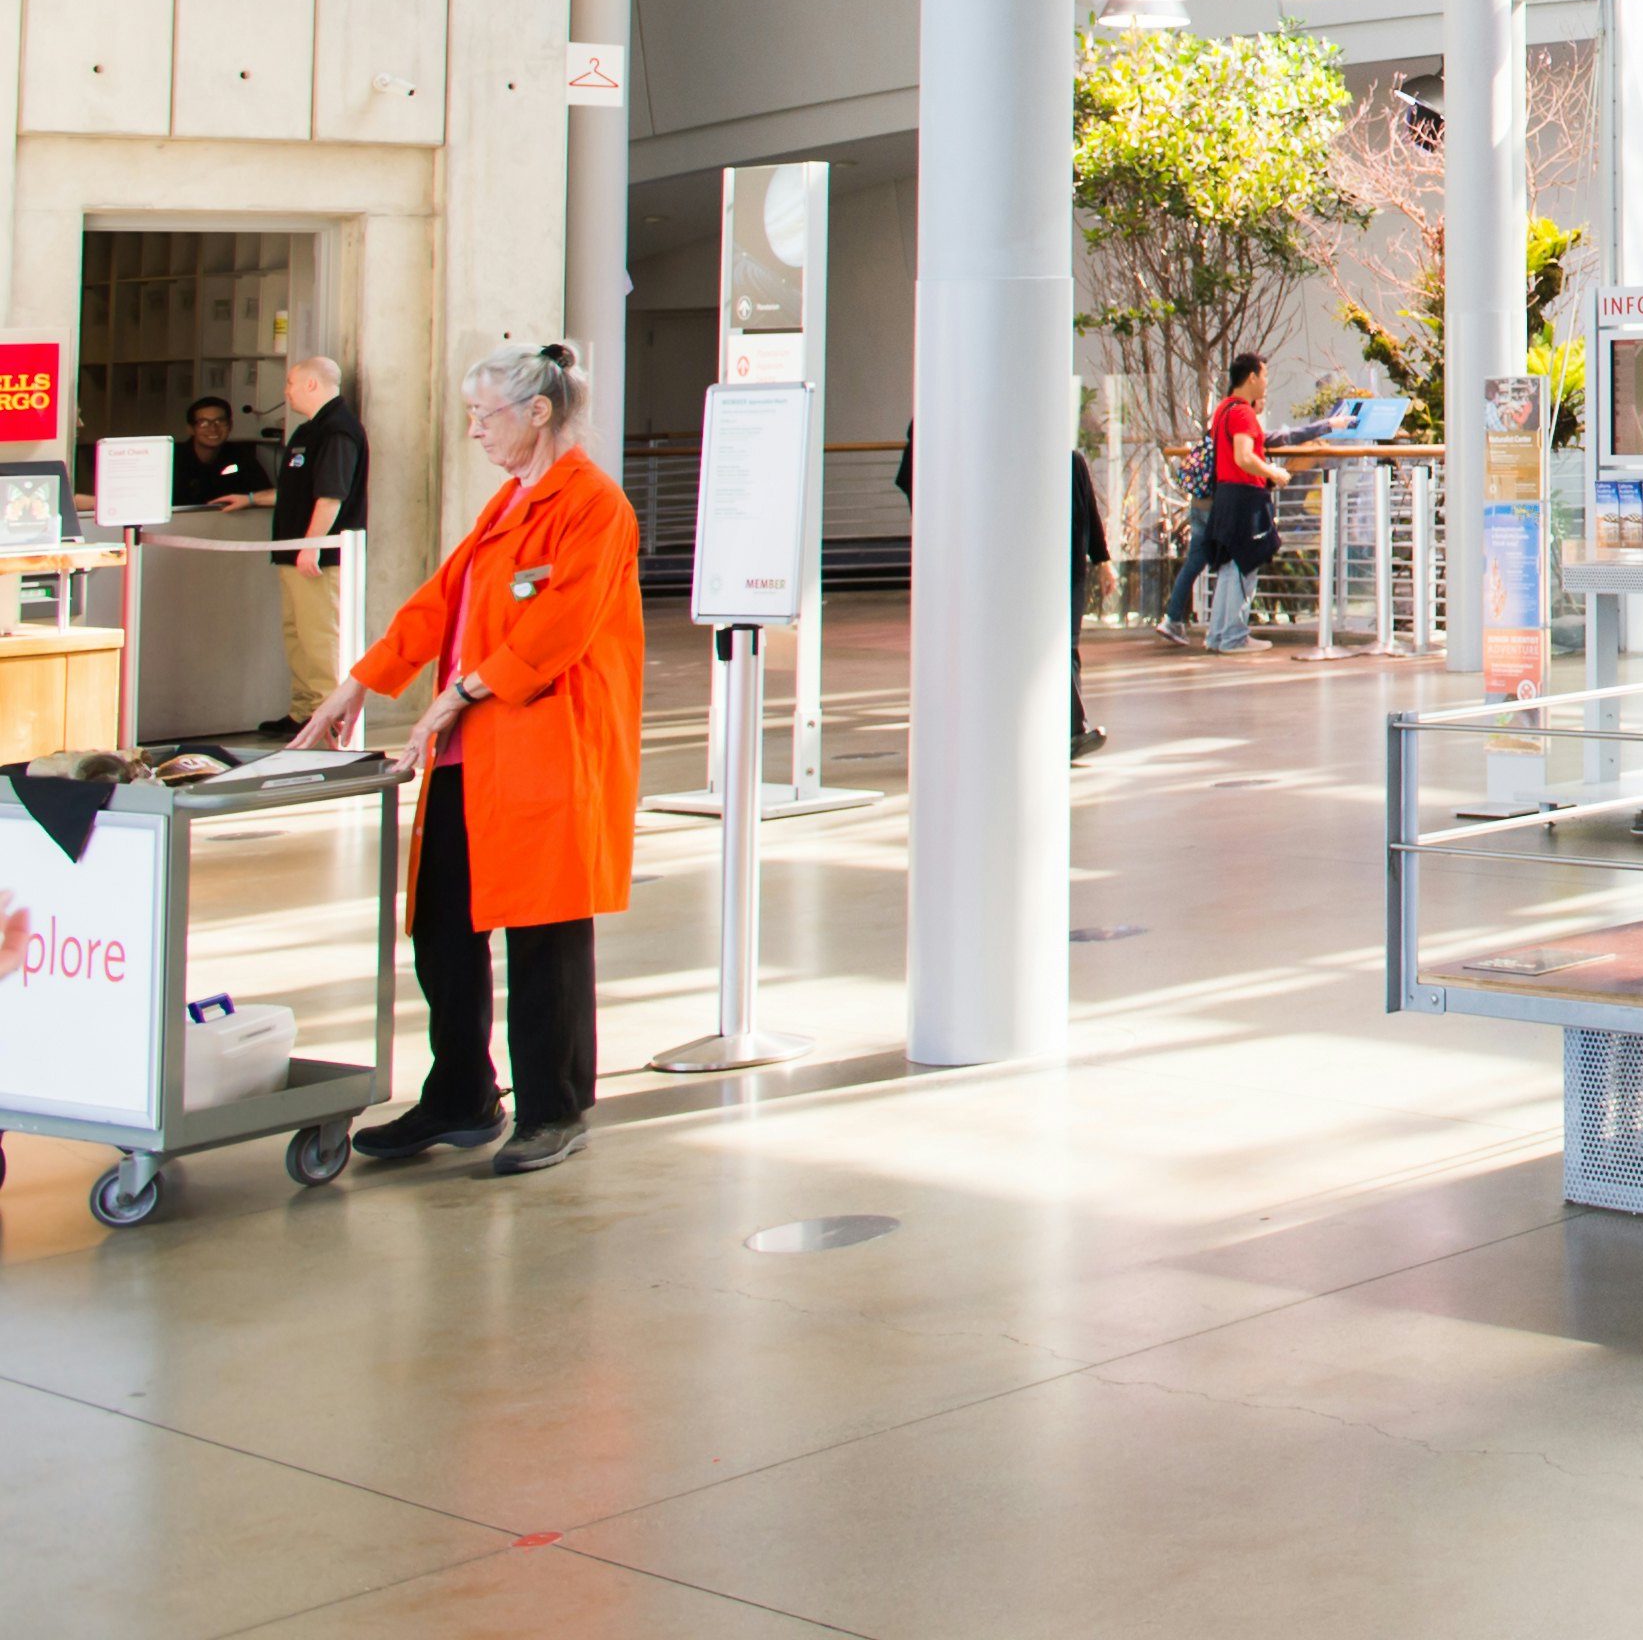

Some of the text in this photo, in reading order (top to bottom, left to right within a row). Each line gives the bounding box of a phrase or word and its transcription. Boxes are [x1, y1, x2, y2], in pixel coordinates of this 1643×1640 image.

[0, 373, 51, 391] LLS
[745, 578, 786, 590] MEMBER
[23, 915, 125, 987] plore
